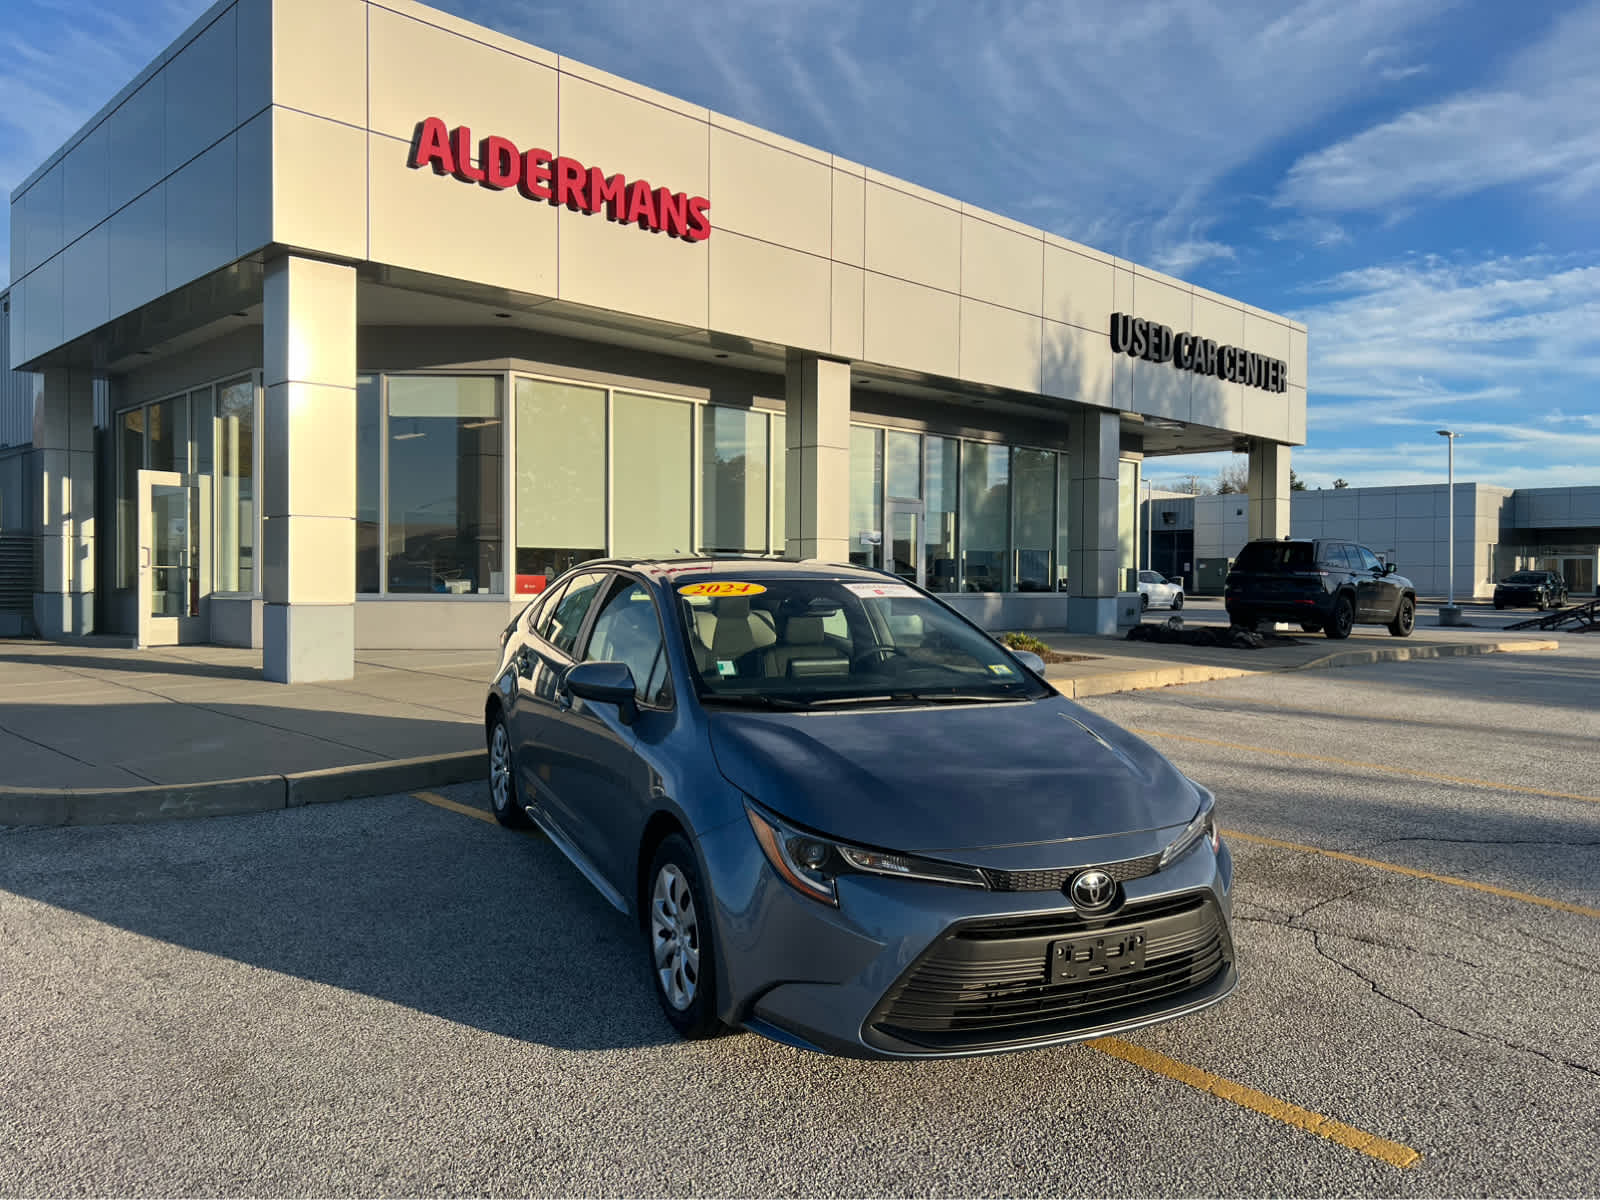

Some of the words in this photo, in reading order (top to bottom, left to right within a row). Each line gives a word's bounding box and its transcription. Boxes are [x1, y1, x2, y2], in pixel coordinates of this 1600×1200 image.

[409, 116, 711, 242] ALDERMANS
[1112, 312, 1174, 362] USED
[1175, 332, 1218, 375] CAR
[1219, 345, 1288, 393] CENTER
[692, 583, 750, 594] 2024
